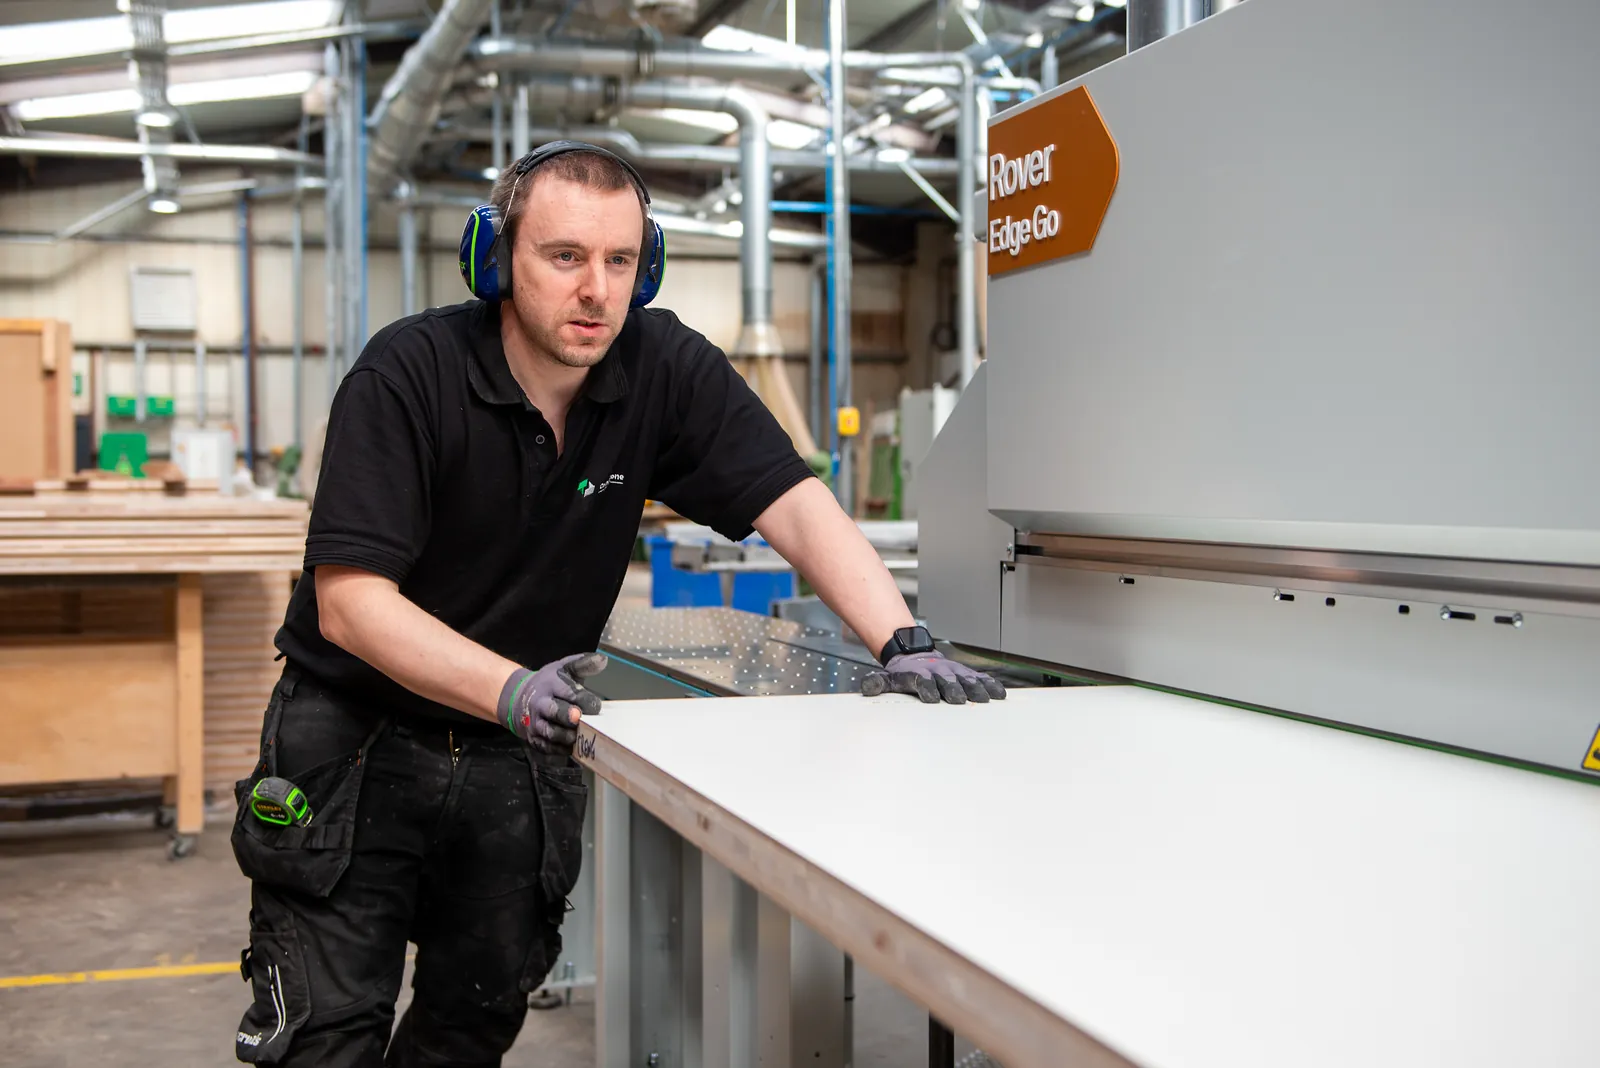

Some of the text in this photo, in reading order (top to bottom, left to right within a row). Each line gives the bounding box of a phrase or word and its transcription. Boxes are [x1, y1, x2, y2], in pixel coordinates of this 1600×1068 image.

[989, 144, 1056, 201] Rover
[989, 204, 1060, 256] Edge Go
